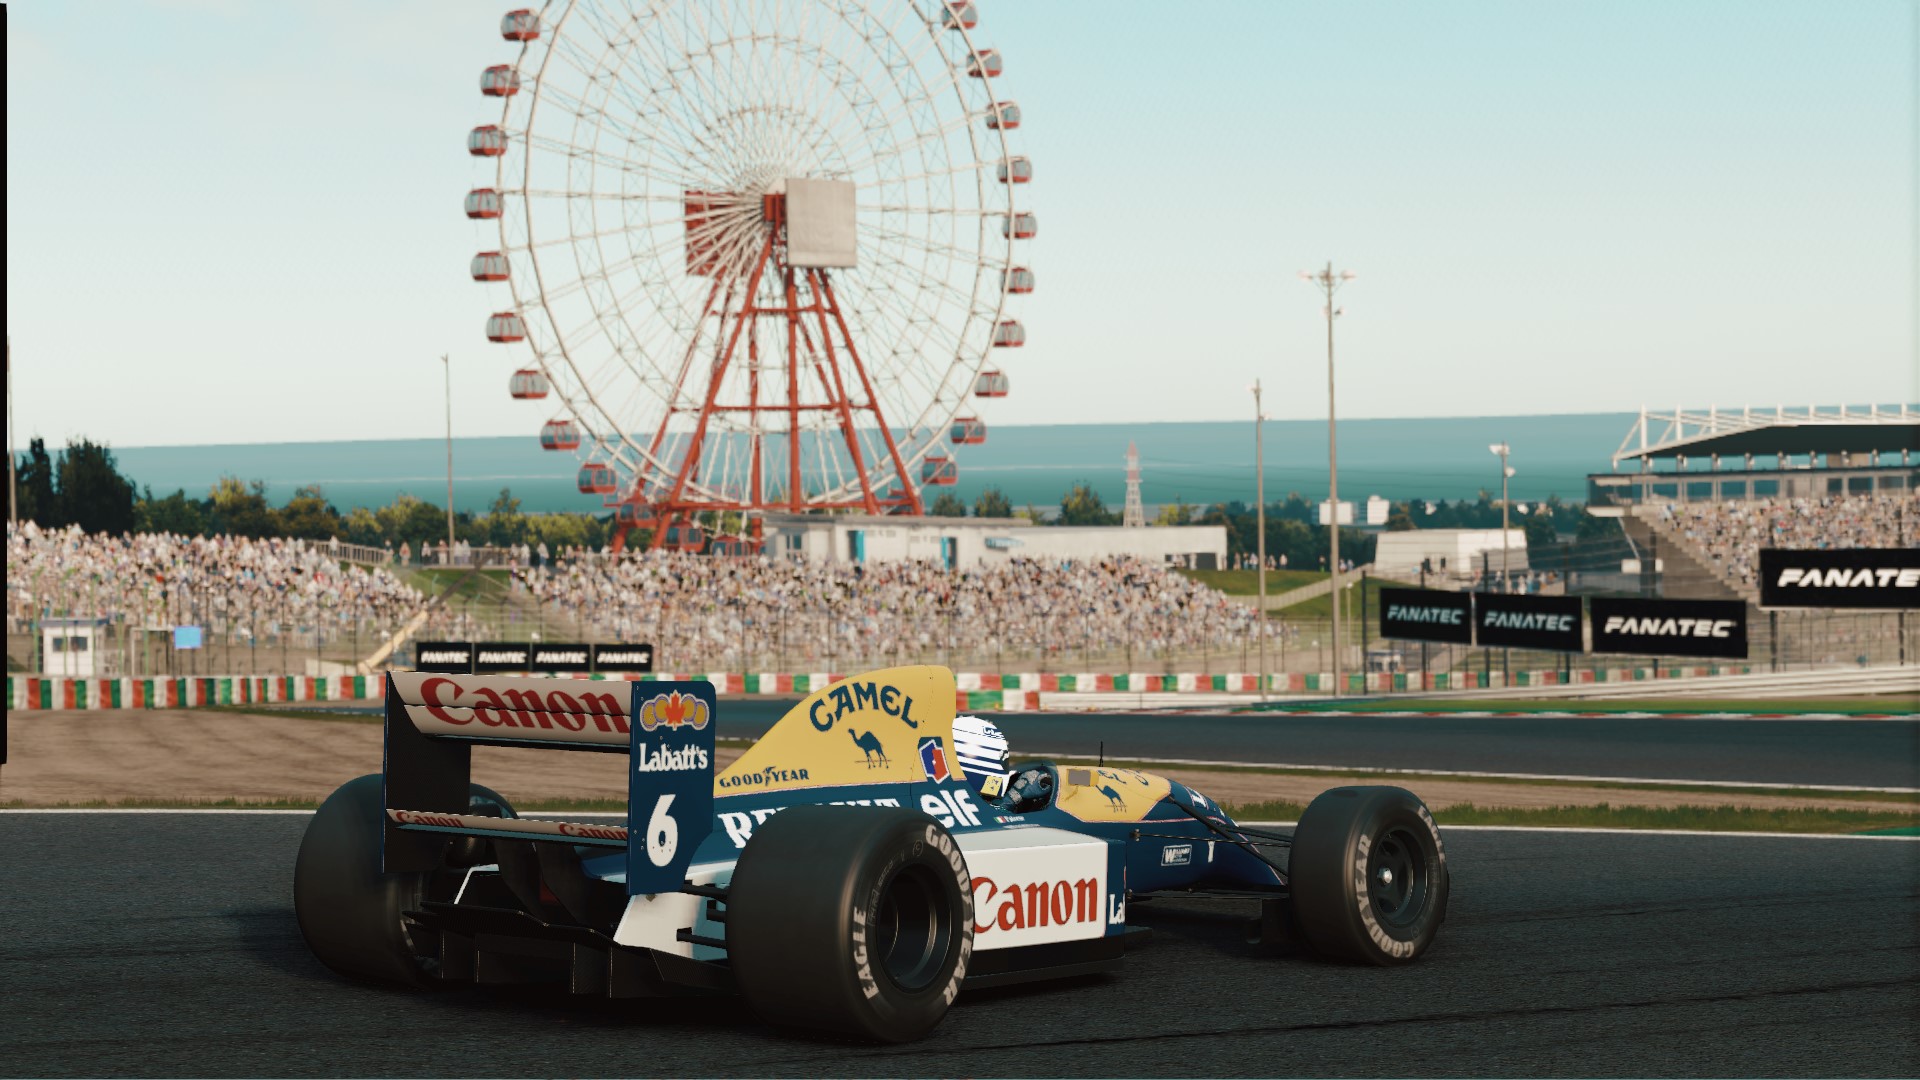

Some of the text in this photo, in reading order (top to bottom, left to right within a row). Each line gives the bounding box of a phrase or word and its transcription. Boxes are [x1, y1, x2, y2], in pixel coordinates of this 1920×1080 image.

[1777, 568, 1920, 587] FANATE
[1388, 605, 1463, 625] FANATEC
[1485, 610, 1573, 631] FANATEC
[1605, 616, 1735, 638] FANATEC
[421, 651, 469, 664] FANATEC
[478, 652, 527, 664] FANATEC
[536, 652, 586, 664] FANATEC
[597, 652, 649, 664] FANATEC
[420, 677, 630, 734] Canon
[809, 682, 918, 732] CAMEL
[638, 743, 708, 772] Labatt's
[920, 789, 982, 828] elf
[396, 811, 464, 828] Canon
[559, 823, 628, 839] Canon
[646, 794, 678, 867] 6
[972, 876, 1098, 933] Canon
[853, 906, 879, 1000] EAGLE
